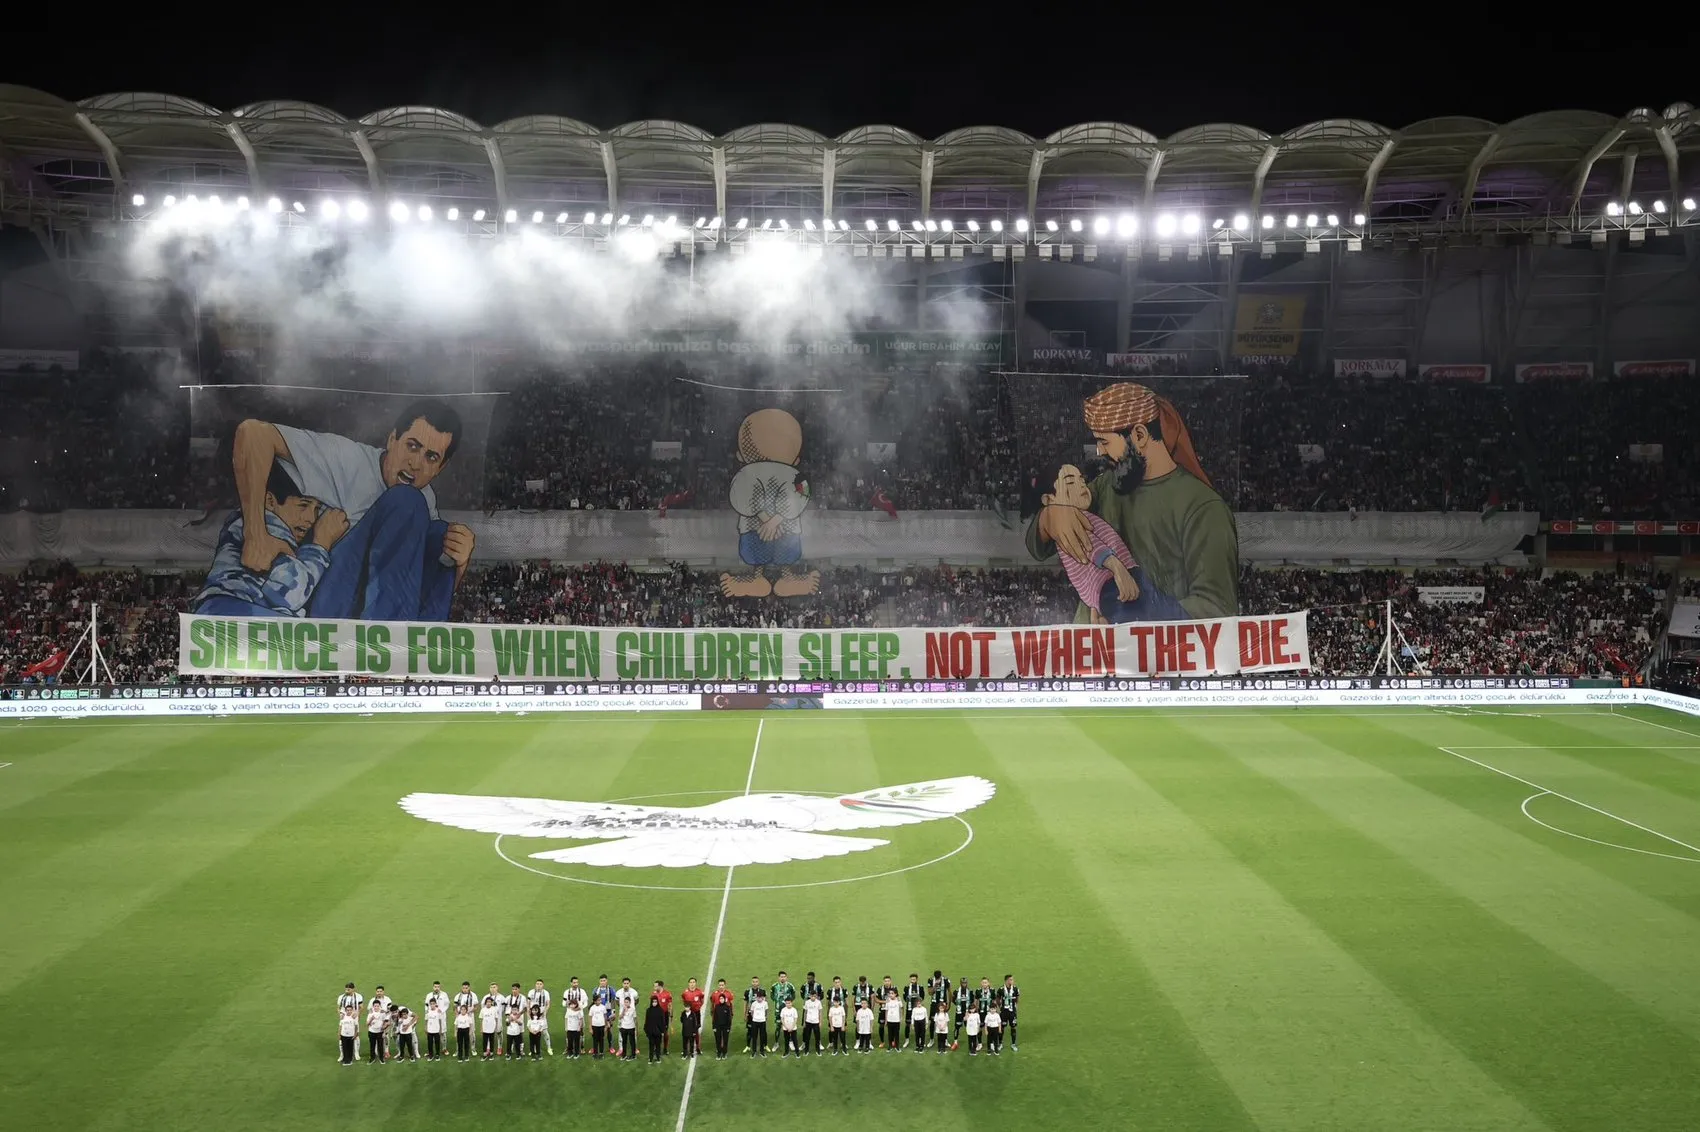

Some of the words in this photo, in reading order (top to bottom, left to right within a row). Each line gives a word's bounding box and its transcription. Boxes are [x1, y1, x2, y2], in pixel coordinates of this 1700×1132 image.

[885, 339, 916, 351] UĞUR
[1033, 350, 1091, 360] KORKMAZ
[1342, 361, 1400, 371] KORKMAZ
[189, 618, 338, 672] SILENCE
[355, 623, 391, 673] IS
[407, 626, 475, 675] FOR
[491, 629, 599, 678] WHEN
[615, 631, 783, 679] CHILDREN
[798, 632, 910, 679] SLEEP.
[925, 631, 996, 678] NOT
[1012, 628, 1116, 676] WHEN
[1130, 623, 1222, 673] THEY
[1237, 618, 1301, 667] DIE.
[833, 697, 878, 705] Gazze'de
[891, 698, 918, 706] yaşın
[1238, 695, 1268, 704] çocuk
[1396, 694, 1421, 702] yaşın
[1424, 693, 1457, 701] altında
[1460, 693, 1482, 701] 1029
[1486, 693, 1516, 702] çocuk
[20, 705, 48, 713] 1029
[51, 704, 87, 713] çocuk
[90, 703, 145, 712] öldürüldü
[168, 703, 218, 711] Gazze'de
[232, 704, 260, 712] yaşın
[264, 702, 300, 710] altında
[304, 702, 329, 710] 1029
[333, 701, 367, 711] çocuk
[371, 700, 422, 709] öldürüldü
[536, 700, 572, 708] altında
[603, 699, 635, 708] çocuk
[639, 698, 689, 706] öldürüldü
